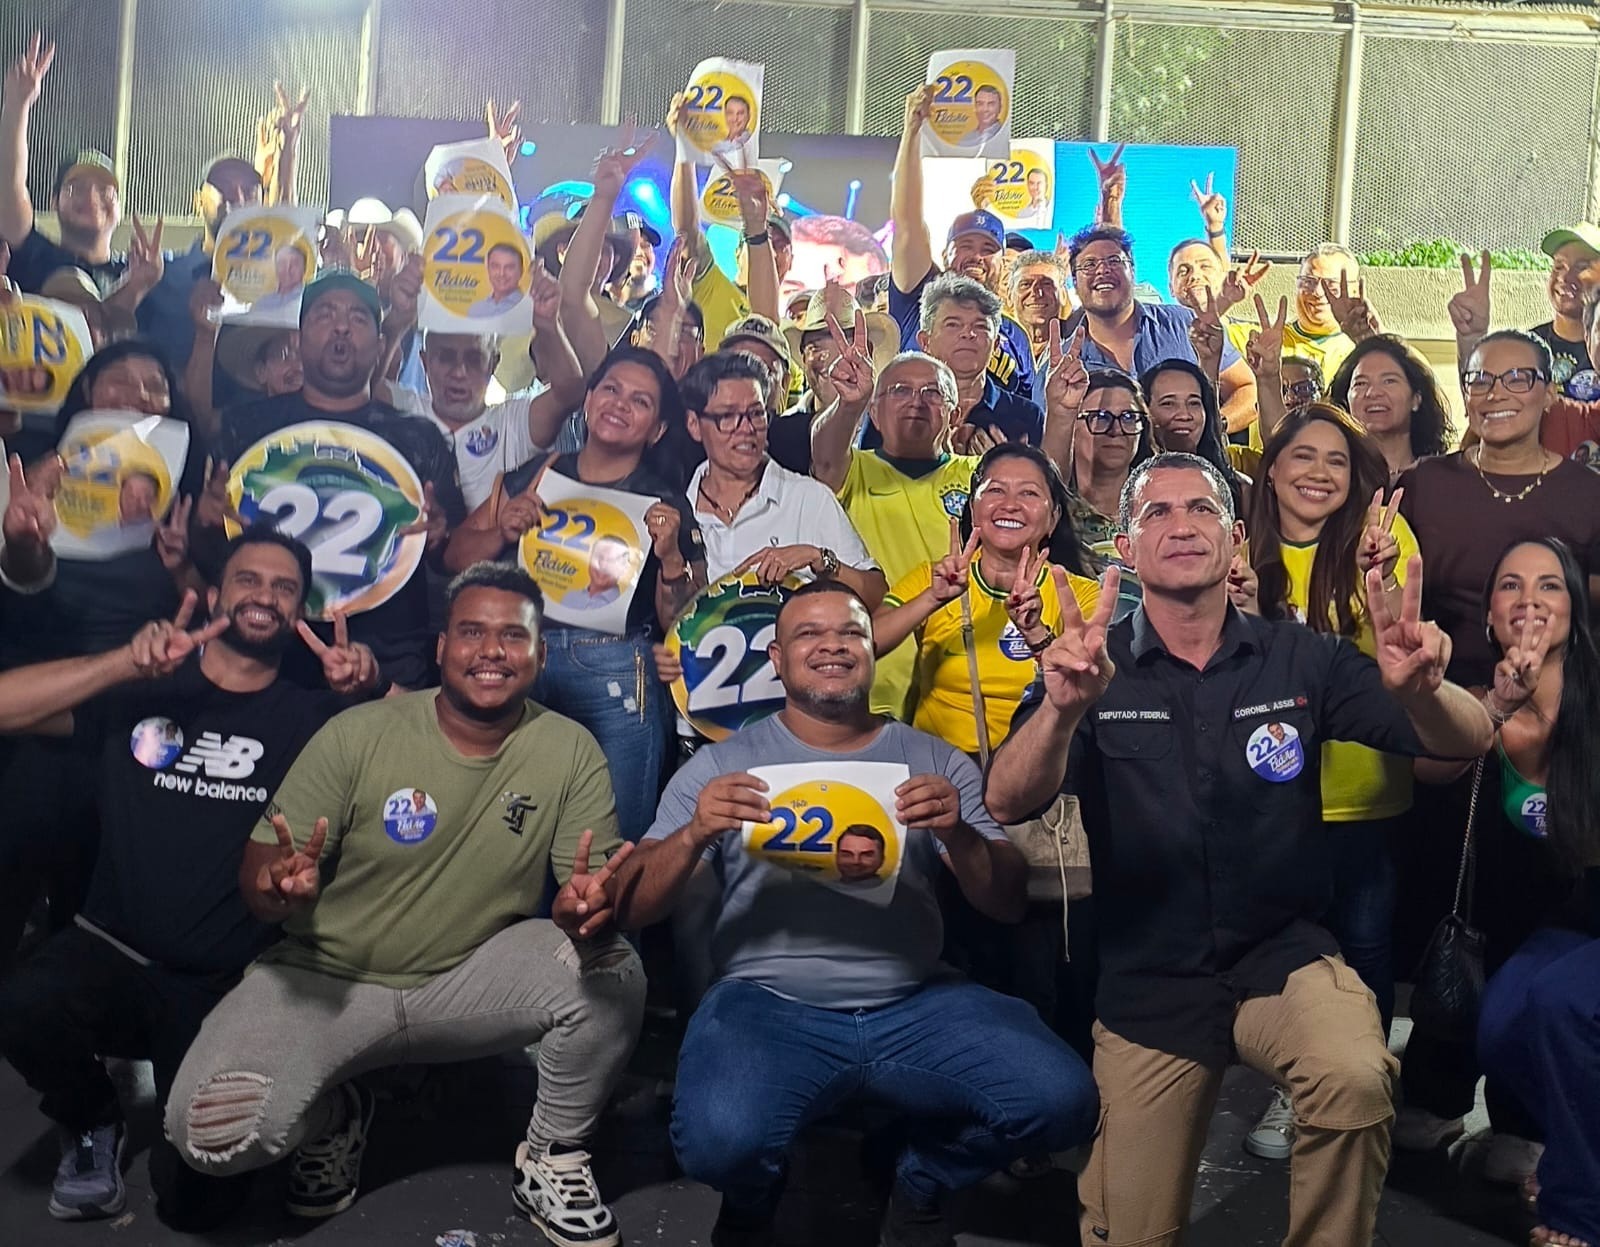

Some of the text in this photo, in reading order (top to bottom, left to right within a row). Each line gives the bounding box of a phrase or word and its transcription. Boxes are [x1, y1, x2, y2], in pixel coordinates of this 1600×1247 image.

[687, 85, 723, 111] 22
[936, 75, 973, 103] 22
[993, 161, 1025, 184] 22
[712, 178, 739, 196] 2
[225, 229, 274, 260] 22
[432, 226, 486, 264] 22
[258, 483, 384, 577] 22
[537, 508, 596, 553] 22
[687, 623, 787, 713] 22
[1098, 710, 1170, 720] DEPUTADO FEDERAL
[1234, 704, 1270, 718] CORONEL
[1273, 698, 1295, 710] ASSIS
[1249, 736, 1278, 762] 22
[194, 777, 268, 802] balance
[388, 798, 413, 816] 22
[1527, 800, 1547, 814] 22
[762, 806, 834, 852] 22
